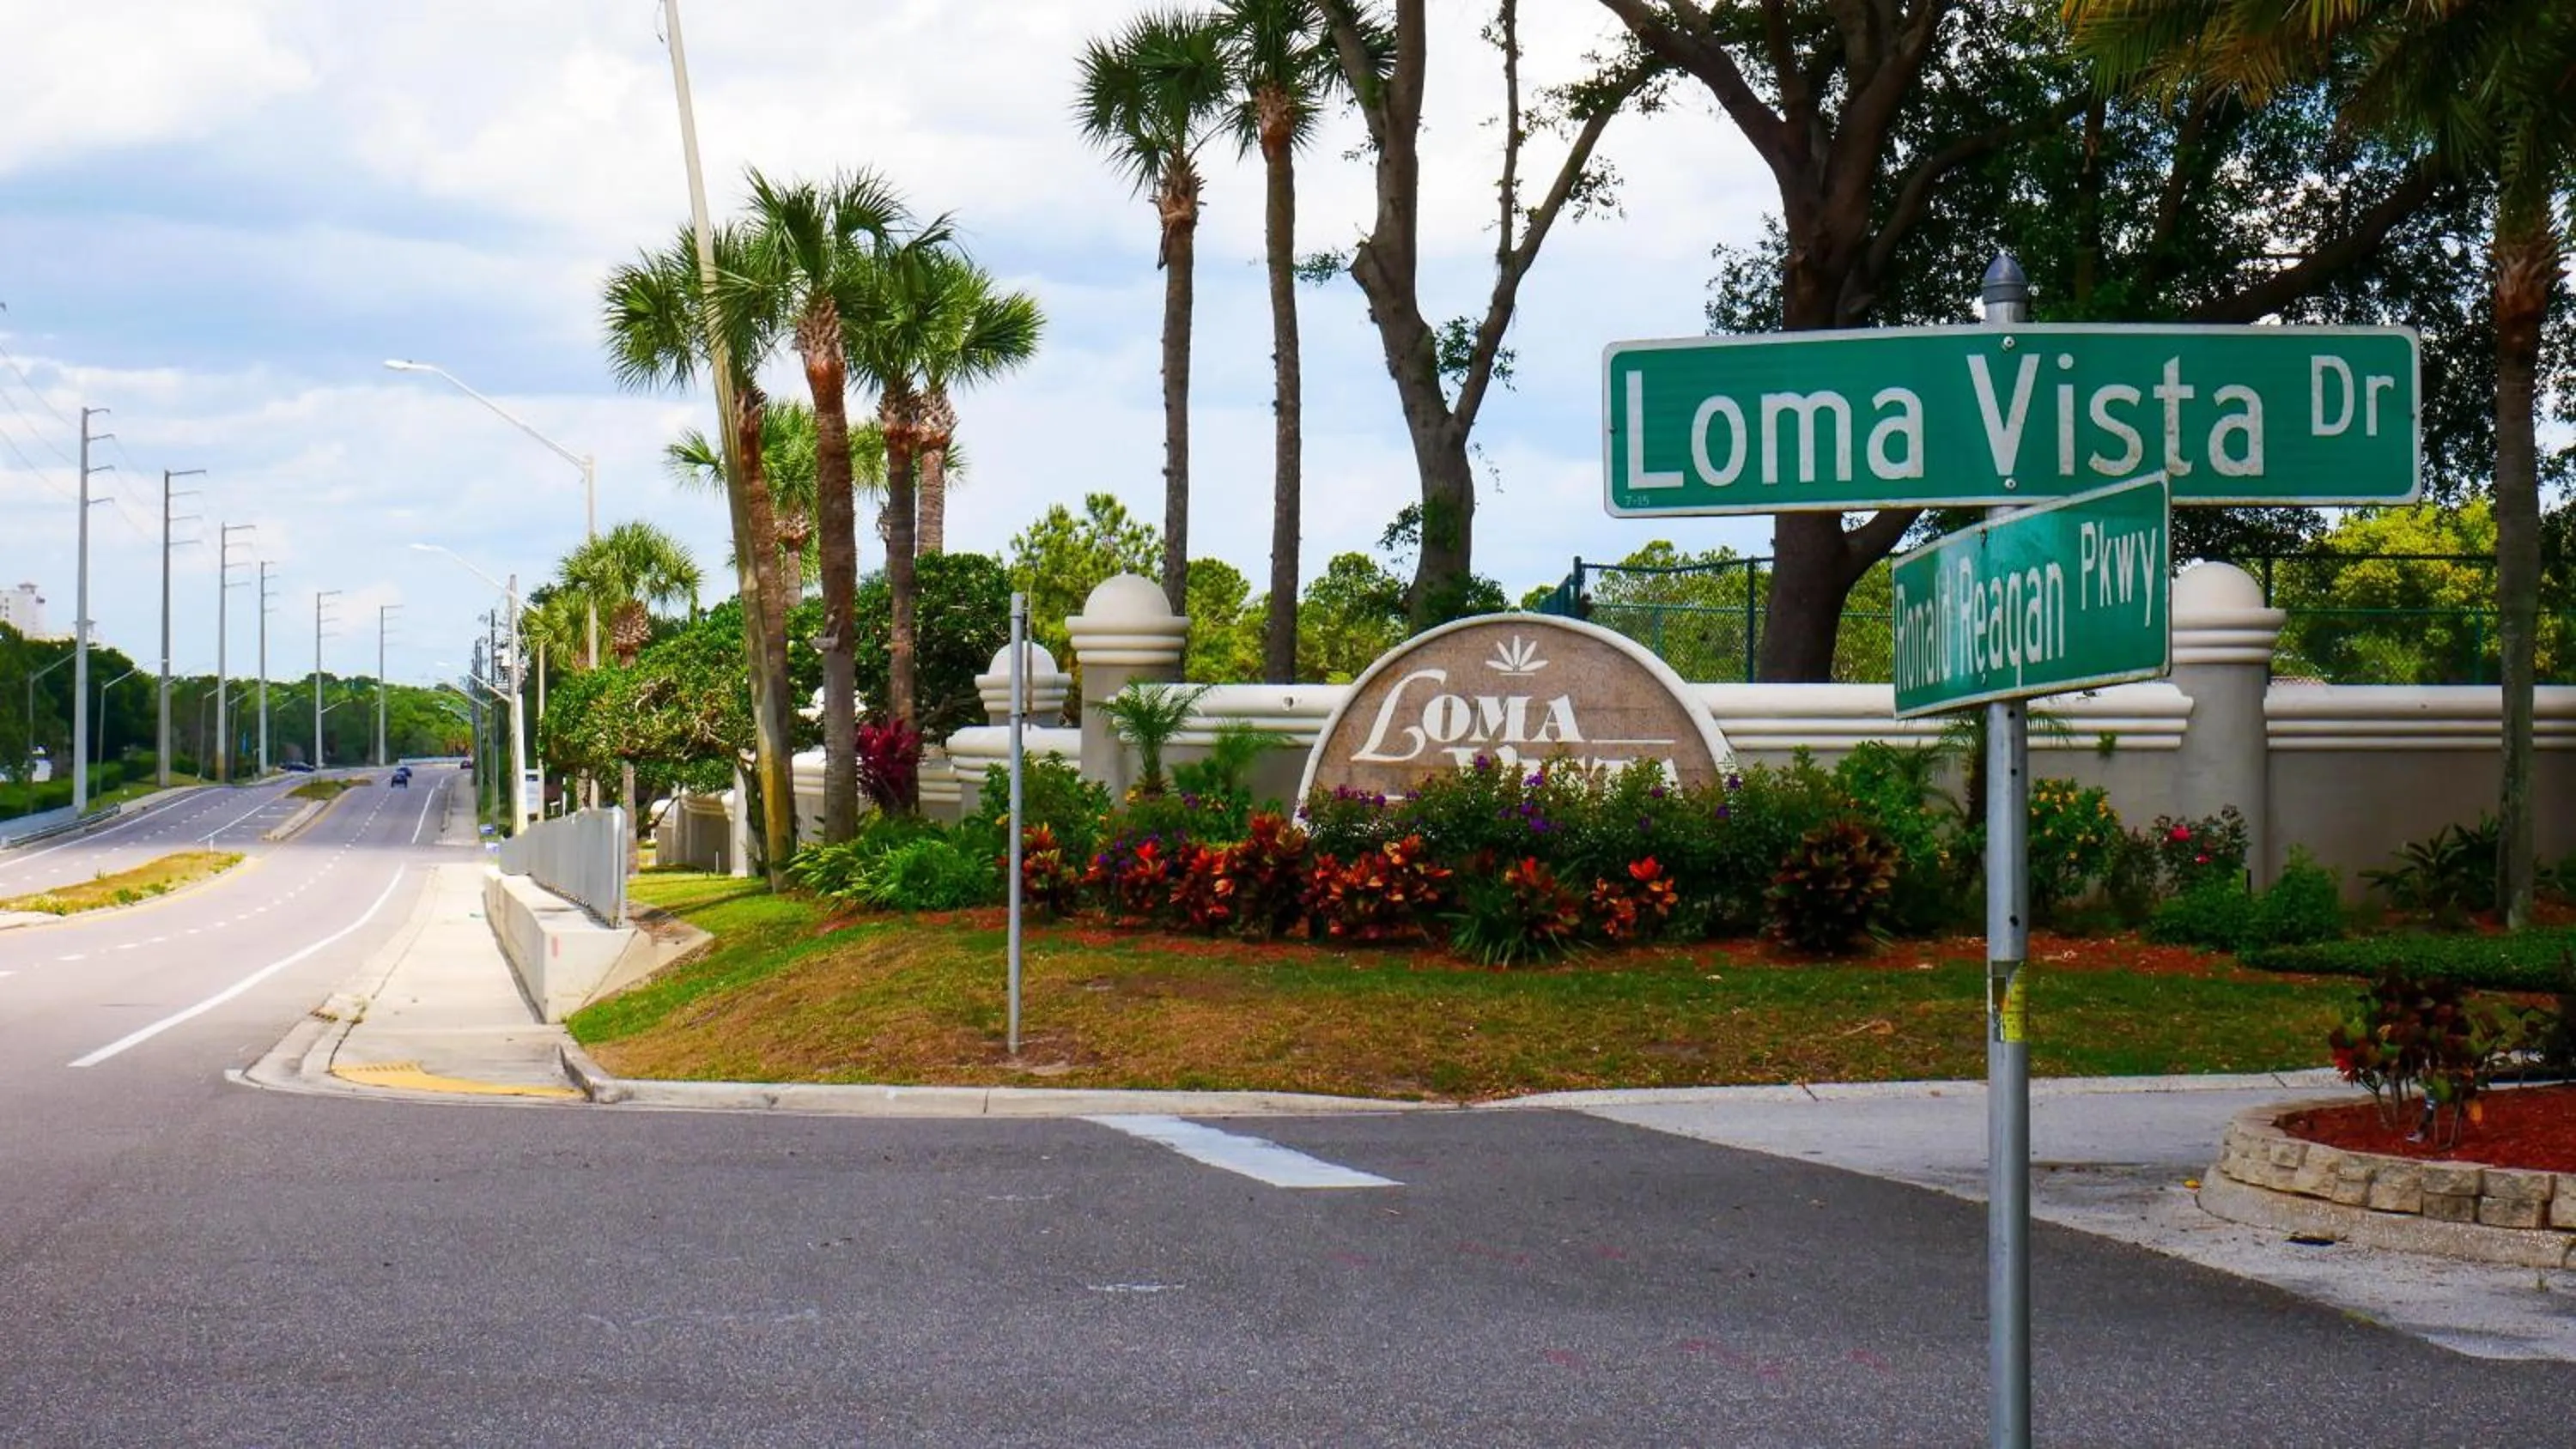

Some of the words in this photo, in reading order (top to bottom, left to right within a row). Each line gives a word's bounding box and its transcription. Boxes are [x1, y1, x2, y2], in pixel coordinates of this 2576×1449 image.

[1626, 370, 1923, 489] Loma
[1967, 354, 2263, 476] Vista
[2311, 355, 2394, 436] Dr
[1896, 566, 1952, 692] Ronald
[1959, 557, 2064, 686] Reagan
[2081, 521, 2157, 627] Pkwy
[1350, 669, 1584, 761] LOMA
